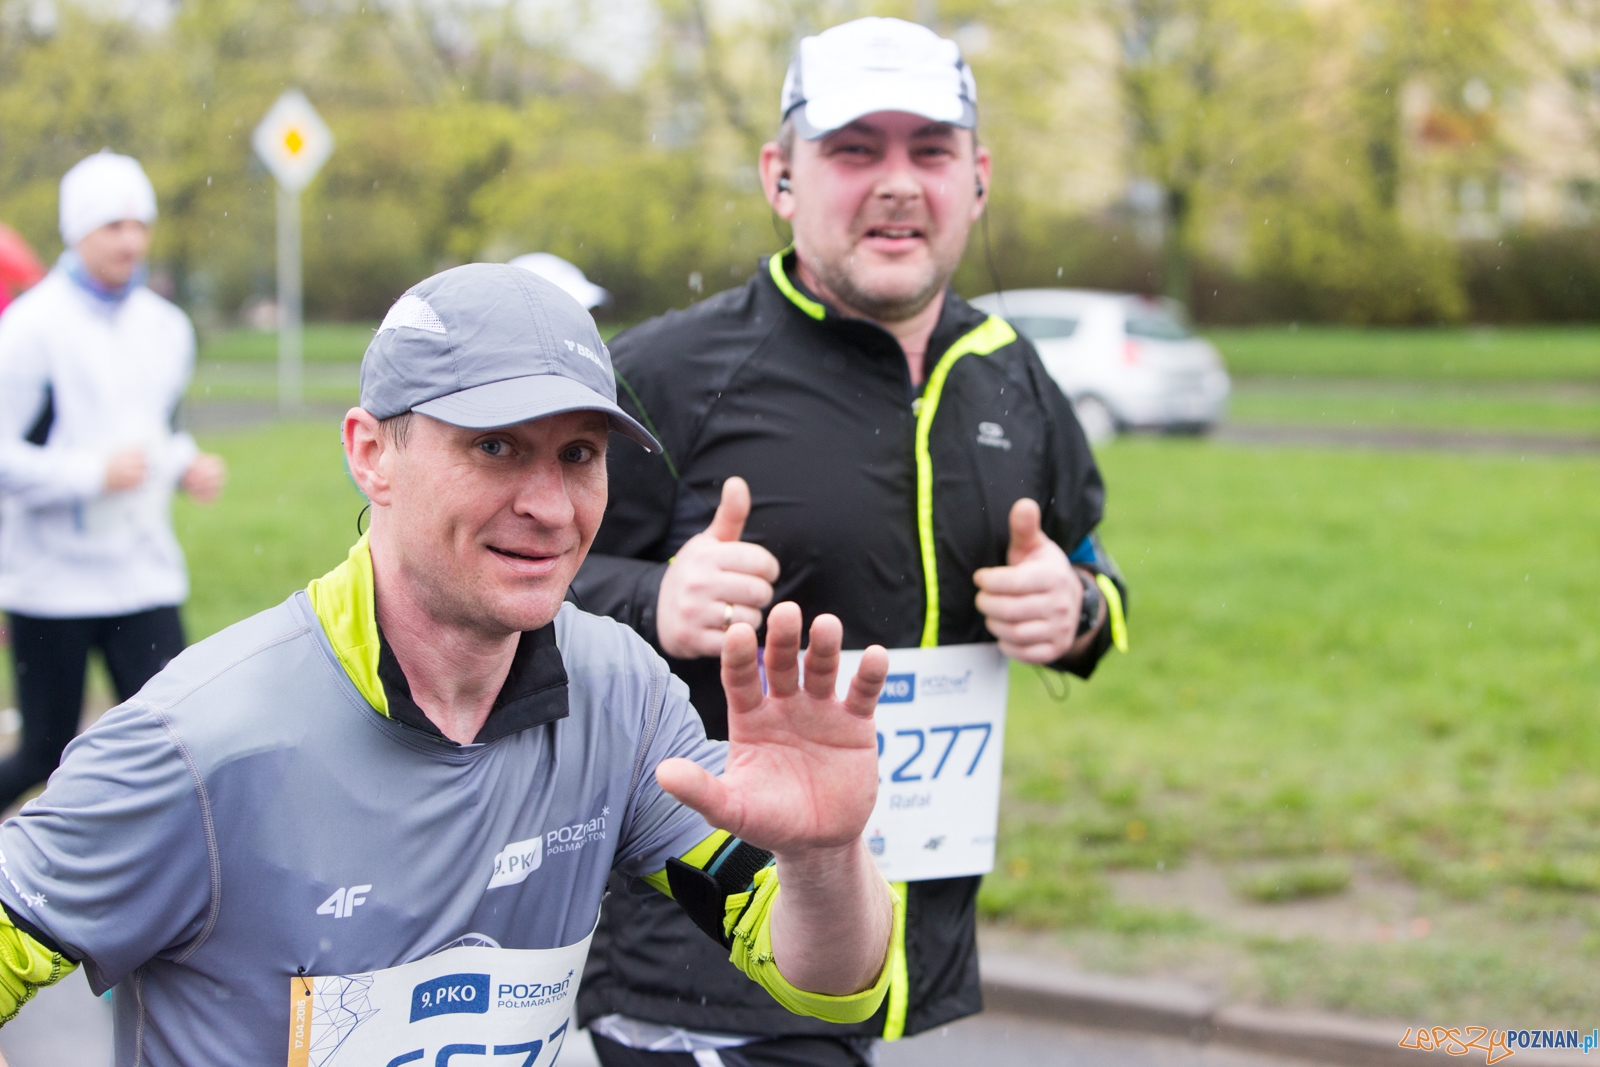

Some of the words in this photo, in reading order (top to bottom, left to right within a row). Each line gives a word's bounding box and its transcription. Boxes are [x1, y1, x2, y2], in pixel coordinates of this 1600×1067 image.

[316, 884, 372, 918] 4F
[436, 984, 477, 1005] PKO
[497, 990, 568, 1009] PÓŁMARATON
[294, 999, 307, 1050] 17.04.2016
